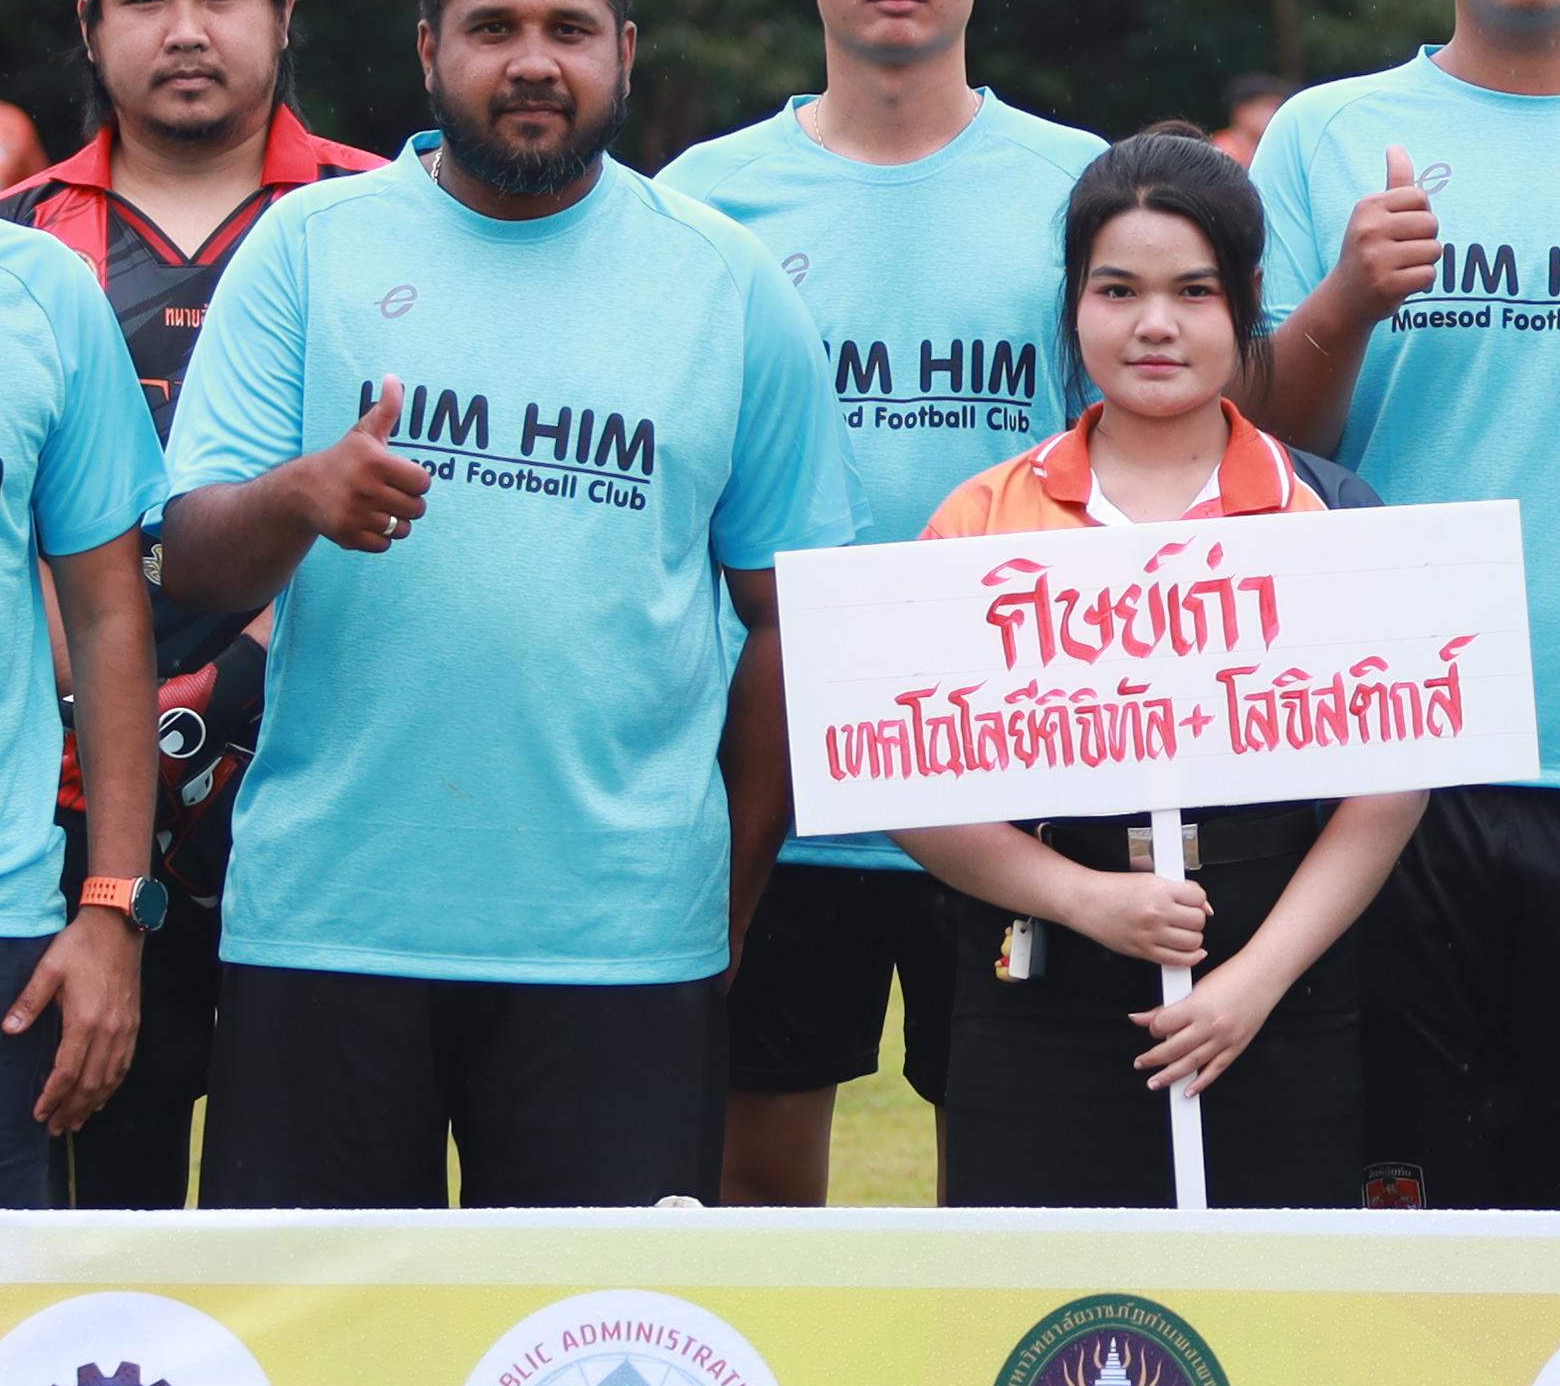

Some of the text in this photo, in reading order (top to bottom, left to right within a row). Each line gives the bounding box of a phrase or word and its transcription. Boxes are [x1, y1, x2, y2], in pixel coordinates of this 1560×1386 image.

[1423, 243, 1519, 296] IM
[1392, 305, 1490, 333] Maesod
[920, 339, 1037, 399] HIM
[520, 402, 655, 475] HIM
[875, 405, 975, 430] Football
[986, 407, 1030, 433] Club
[467, 461, 577, 499] Football
[588, 479, 646, 511] Club
